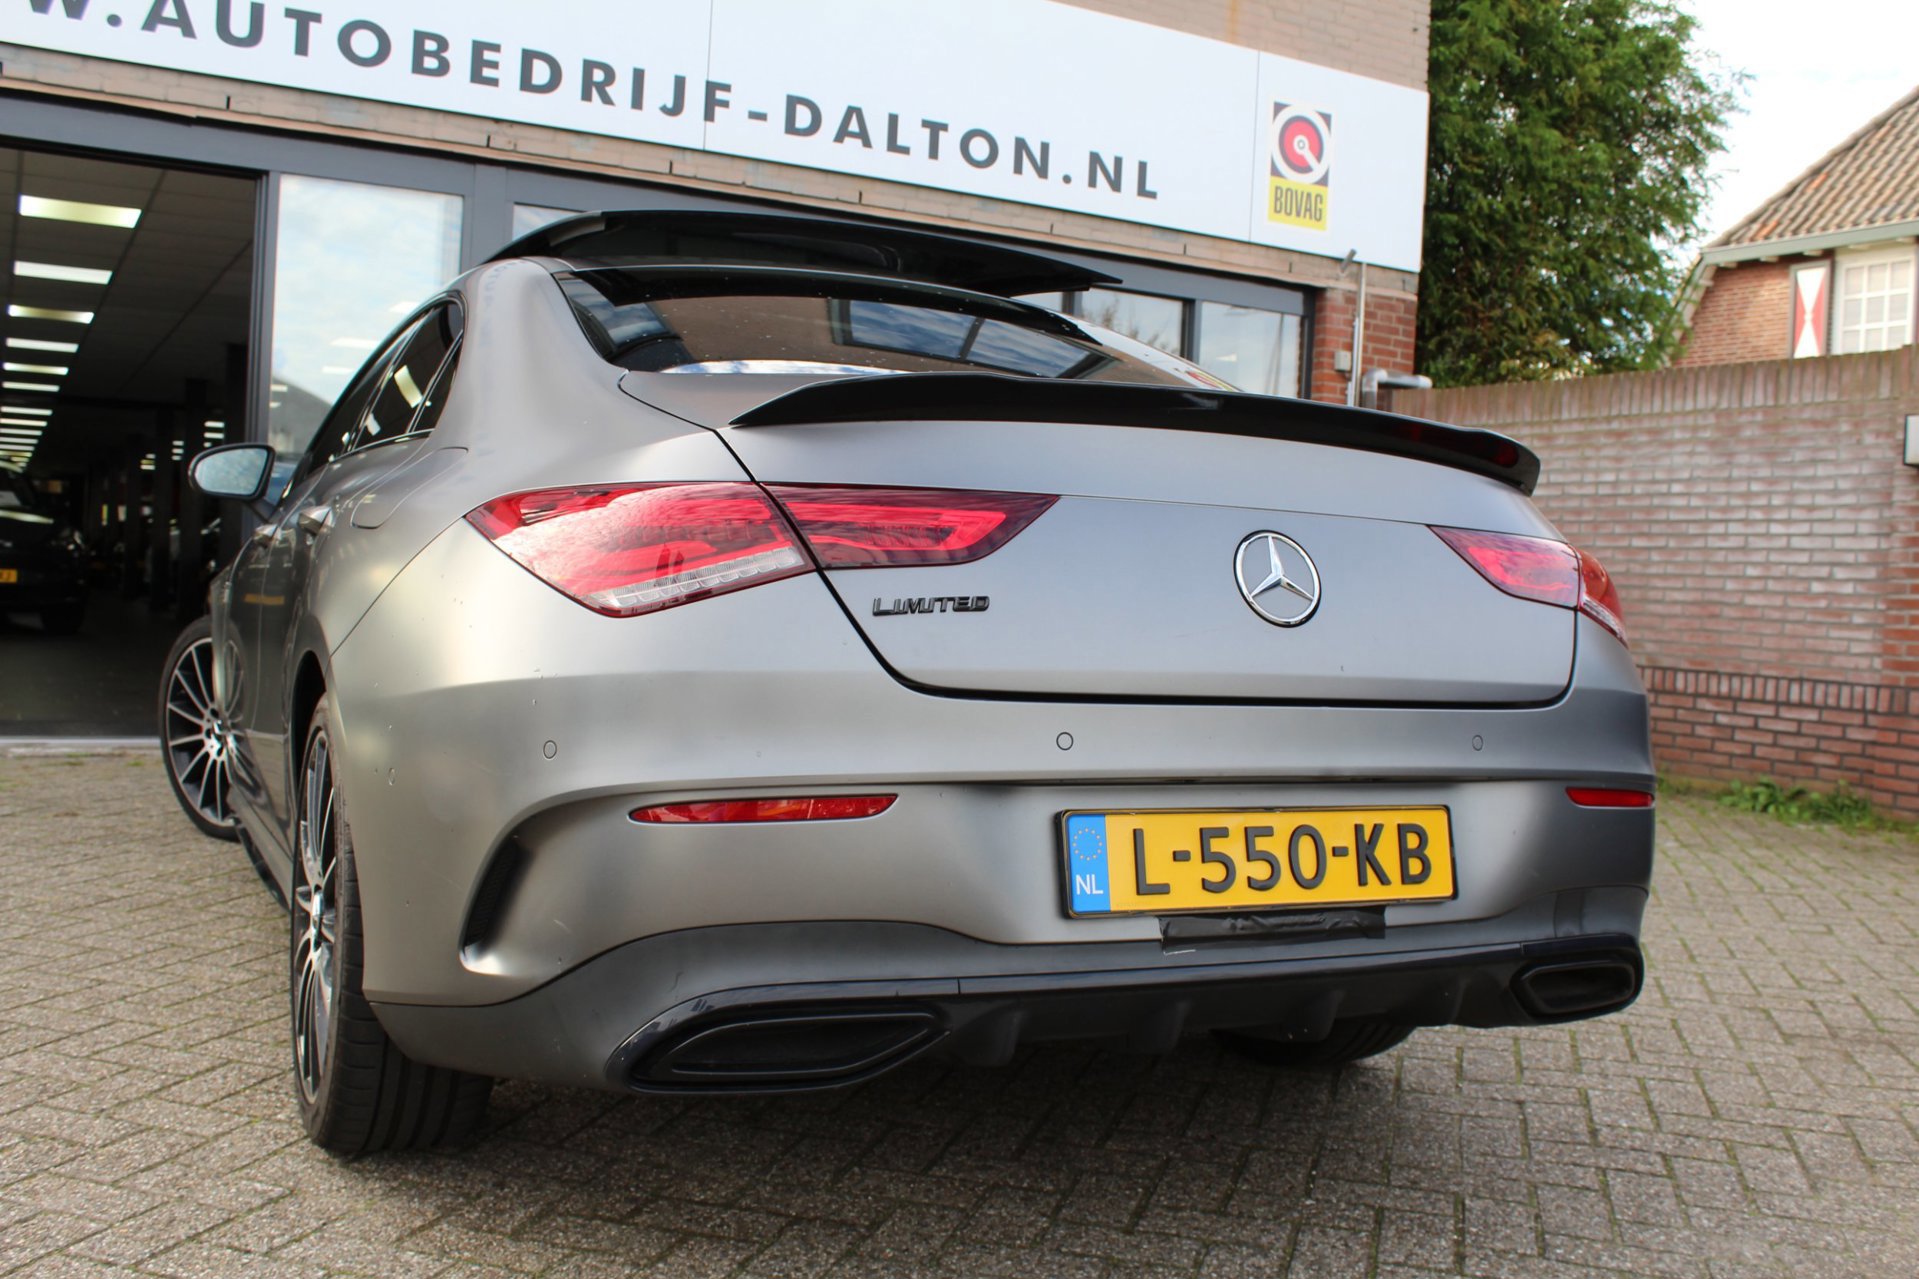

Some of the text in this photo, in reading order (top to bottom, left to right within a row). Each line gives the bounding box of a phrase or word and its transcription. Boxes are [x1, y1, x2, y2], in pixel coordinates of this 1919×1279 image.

[1273, 185, 1323, 222] BOVAG
[872, 596, 990, 616] LIMITED
[1133, 823, 1432, 896] L-550-KB
[1076, 874, 1104, 895] NL
